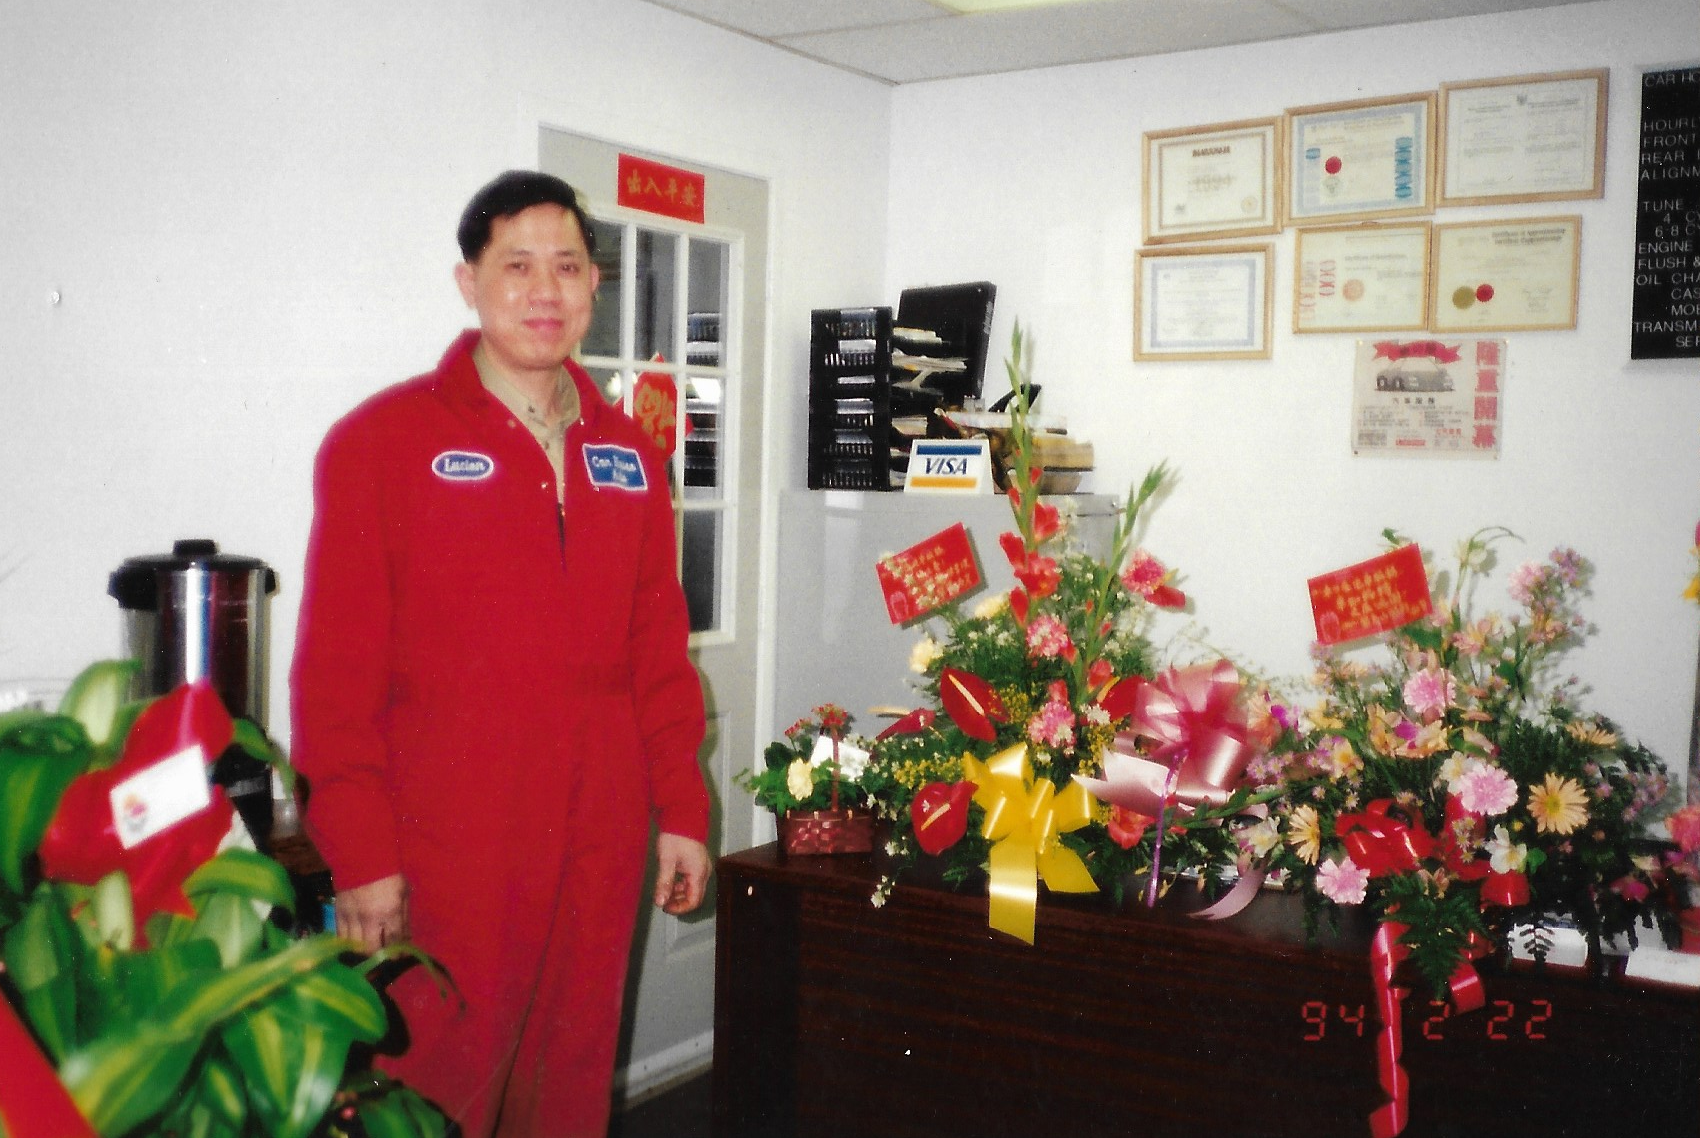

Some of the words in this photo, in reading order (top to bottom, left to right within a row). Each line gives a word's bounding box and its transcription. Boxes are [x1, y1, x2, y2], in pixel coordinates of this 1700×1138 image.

[1644, 73, 1676, 88] CAR
[1643, 116, 1700, 132] HOURL
[1641, 150, 1685, 165] REAR
[1642, 198, 1684, 212] TUNE
[1663, 212, 1671, 224] 4
[1638, 240, 1693, 255] ENGINE
[1638, 256, 1686, 270] FLUSH
[1636, 273, 1662, 286] OIL
[925, 457, 968, 475] VISA
